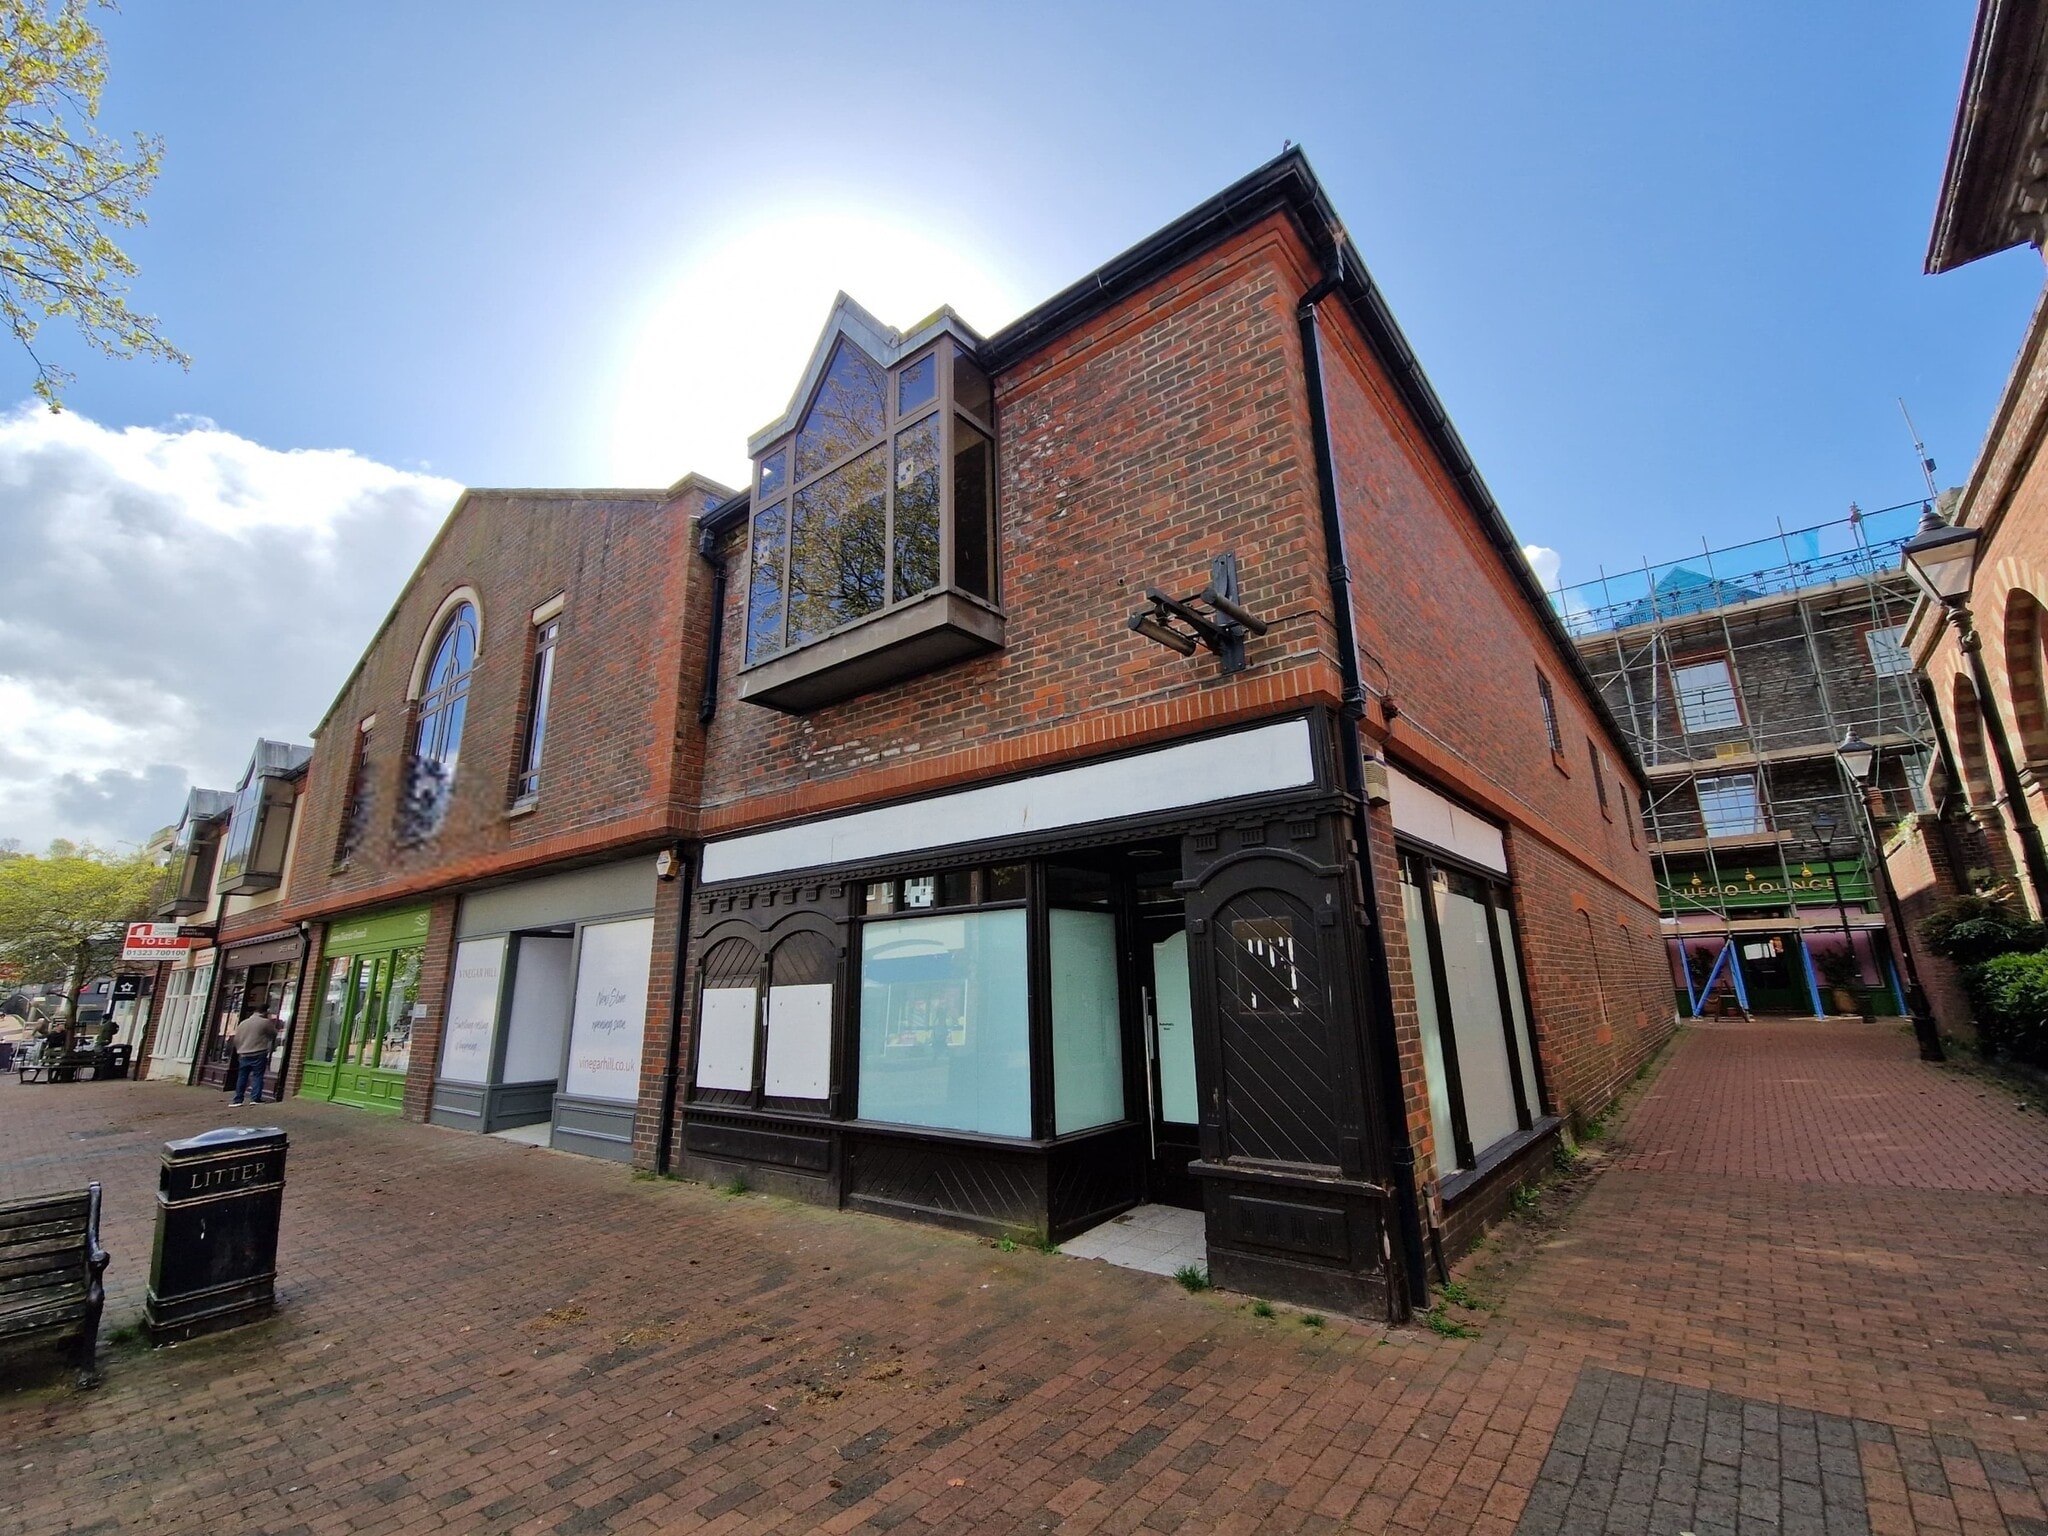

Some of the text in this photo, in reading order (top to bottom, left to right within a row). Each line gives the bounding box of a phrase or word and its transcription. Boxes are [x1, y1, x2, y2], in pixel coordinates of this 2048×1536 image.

[1749, 878, 1835, 895] LOUNGE
[578, 1057, 635, 1073] vinegarhill.co.uk
[191, 1162, 266, 1190] LITTER
